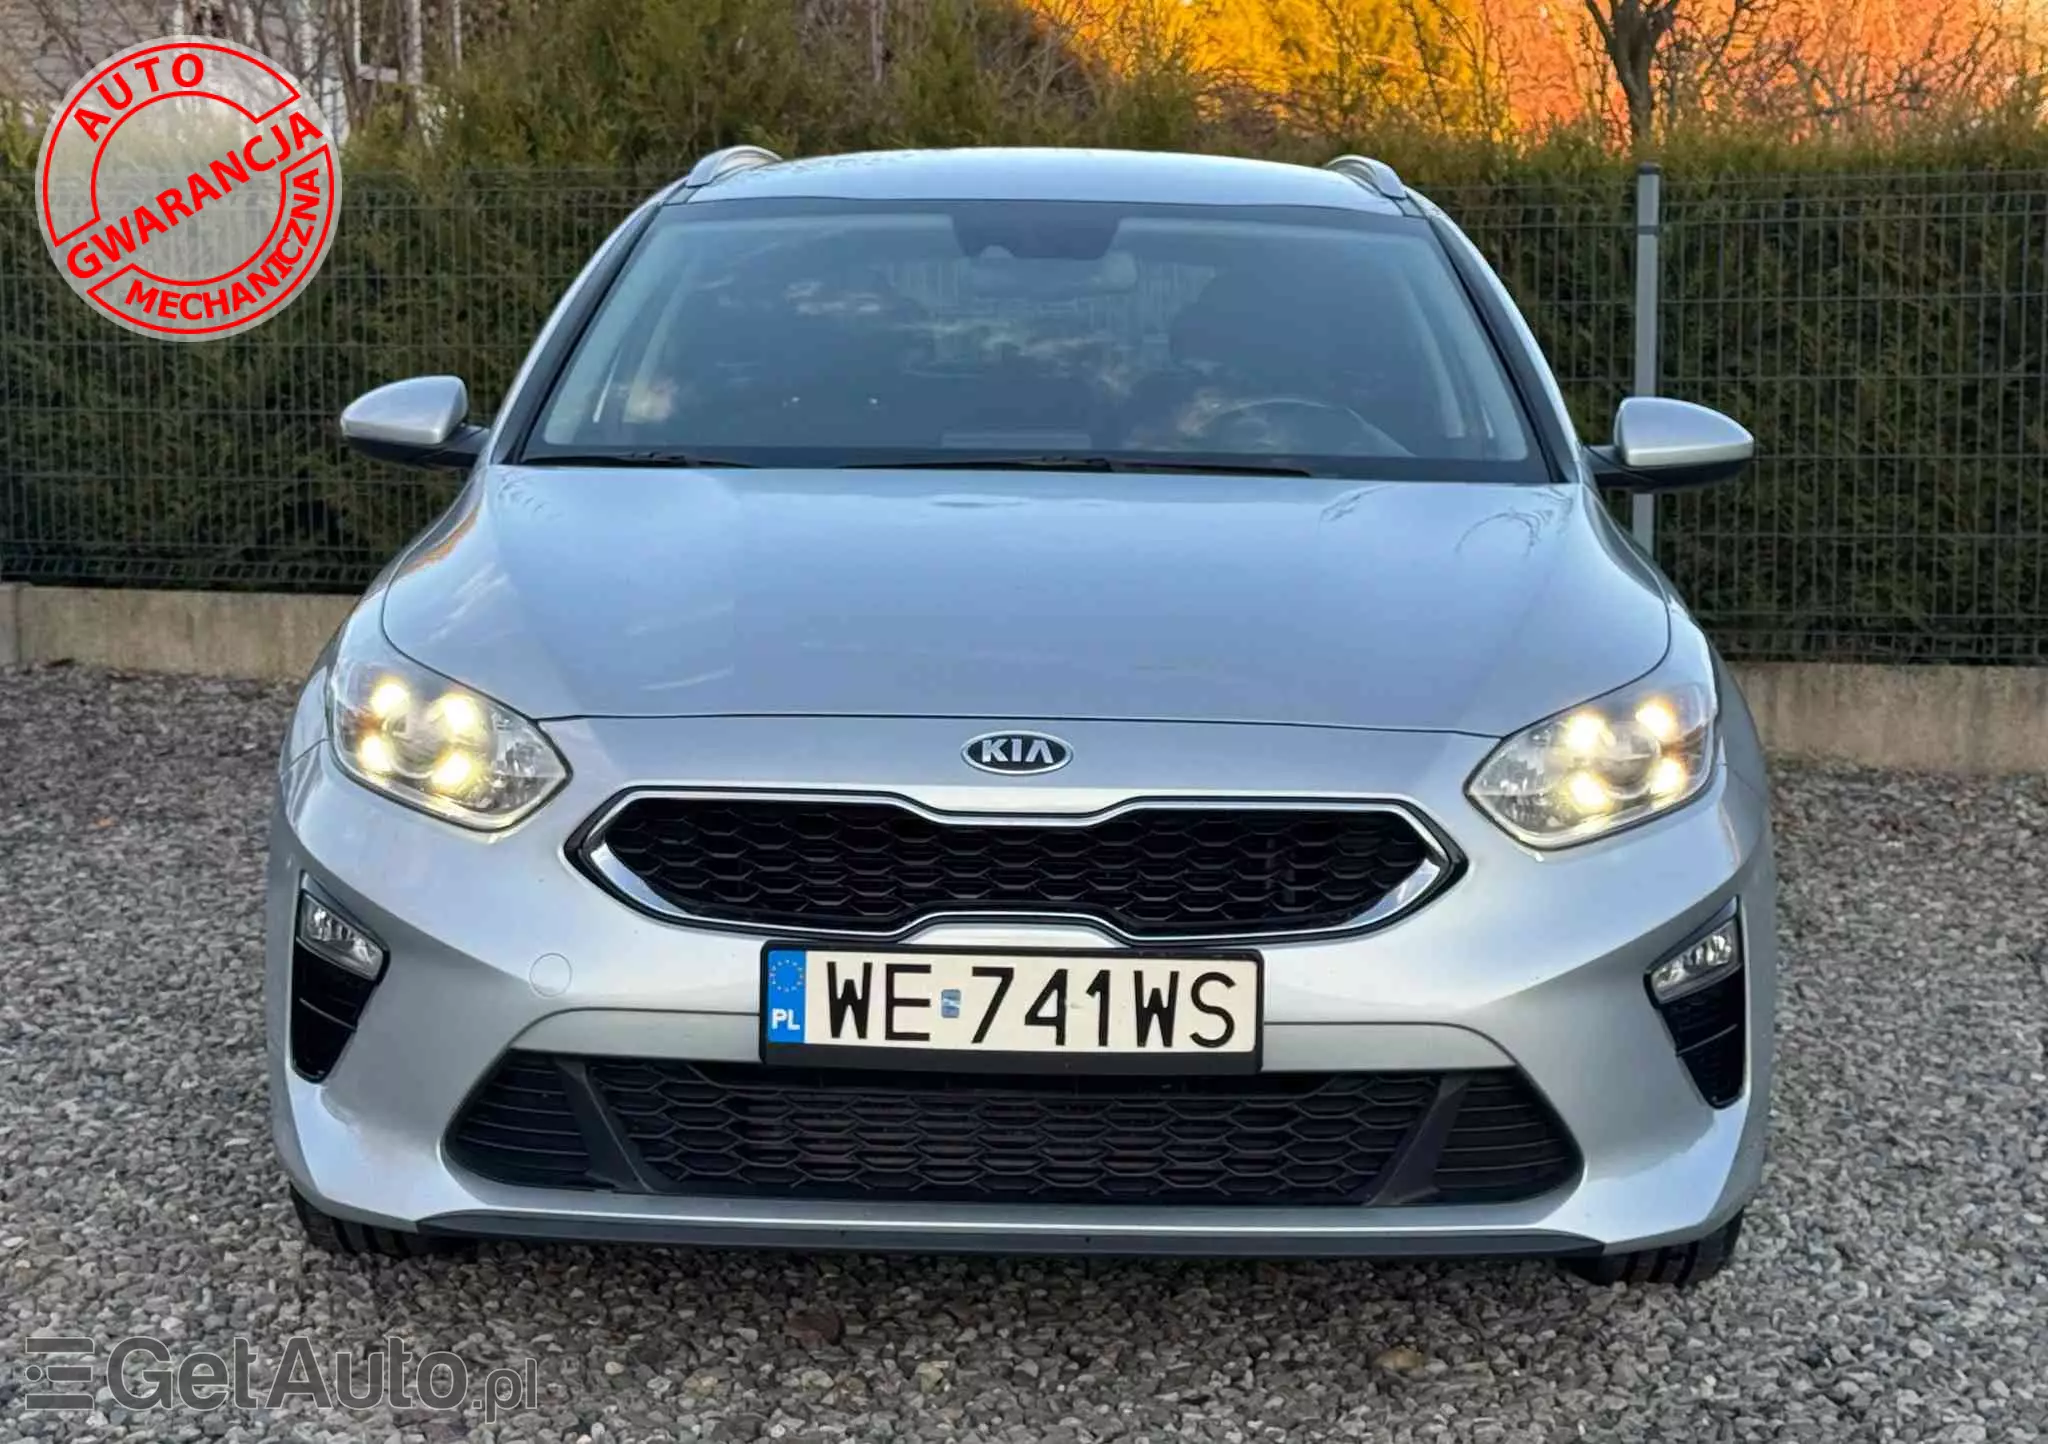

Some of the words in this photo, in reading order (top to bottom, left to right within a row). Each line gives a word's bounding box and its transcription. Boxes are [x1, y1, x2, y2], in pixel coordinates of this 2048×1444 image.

[981, 738, 1054, 764] KIA
[827, 961, 932, 1042] WE
[971, 965, 1237, 1049] 741WS
[772, 1008, 801, 1031] PL
